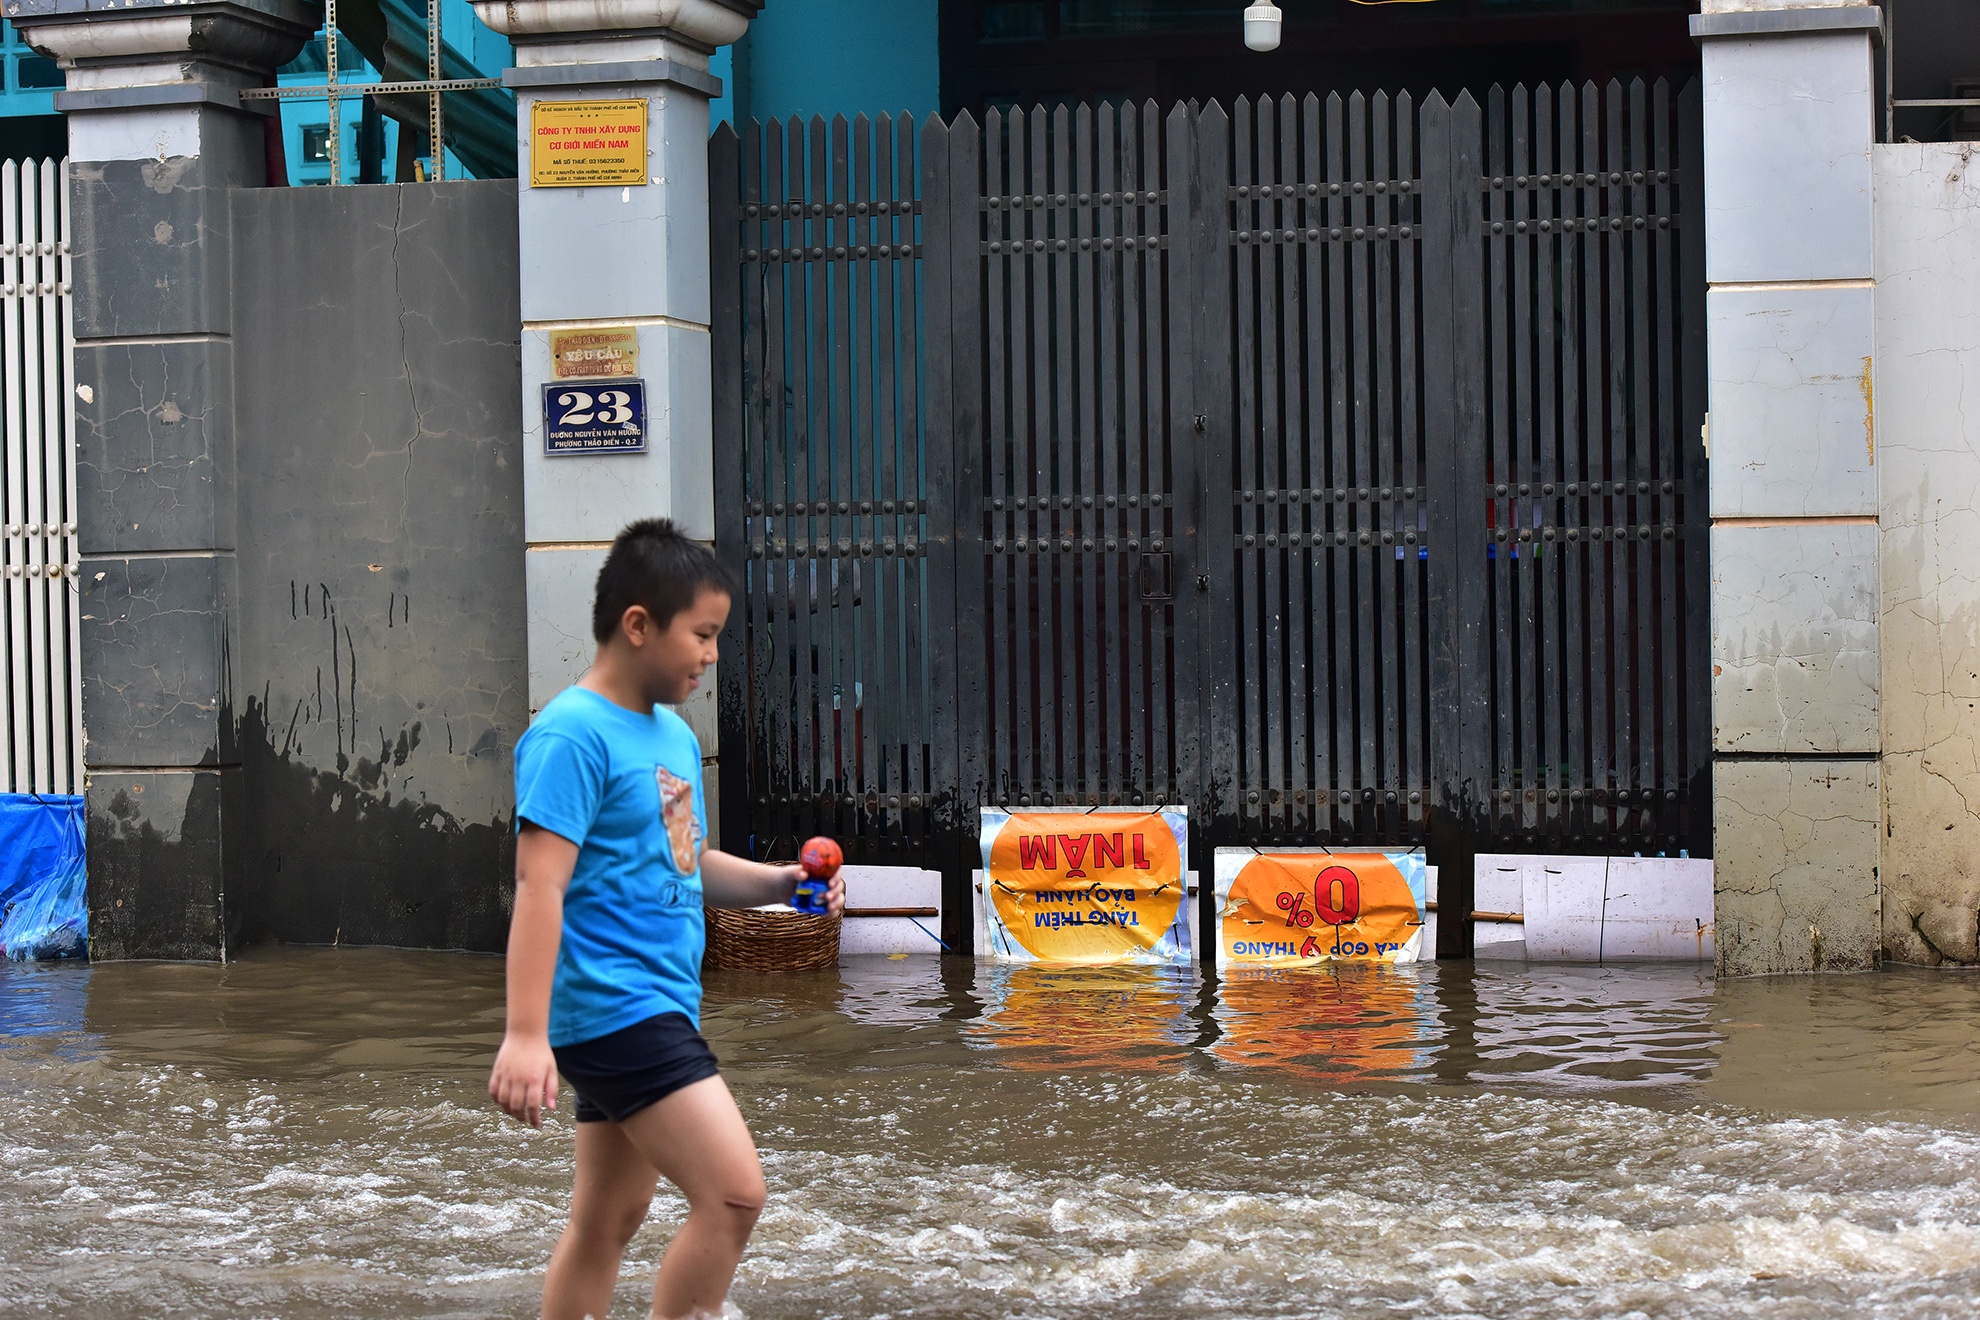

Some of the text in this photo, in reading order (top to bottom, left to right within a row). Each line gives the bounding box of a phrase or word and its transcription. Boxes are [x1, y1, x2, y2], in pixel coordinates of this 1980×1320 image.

[538, 126, 560, 135] CÔNG
[599, 124, 616, 134] XÂY
[618, 125, 640, 134] DỰNG
[550, 138, 628, 150] CƠ GIỚI MIỀN NAM
[558, 390, 633, 426] 23
[575, 428, 601, 438] NGUYỄN
[603, 428, 617, 436] VĂN
[584, 438, 602, 446] THẢO
[1036, 888, 1136, 907] BẢO HÀNH
[1276, 865, 1360, 928] 0%
[1035, 906, 1140, 931] TẶNG THÊM
[1233, 941, 1296, 958] THÁNG
[1300, 936, 1322, 959] 9
